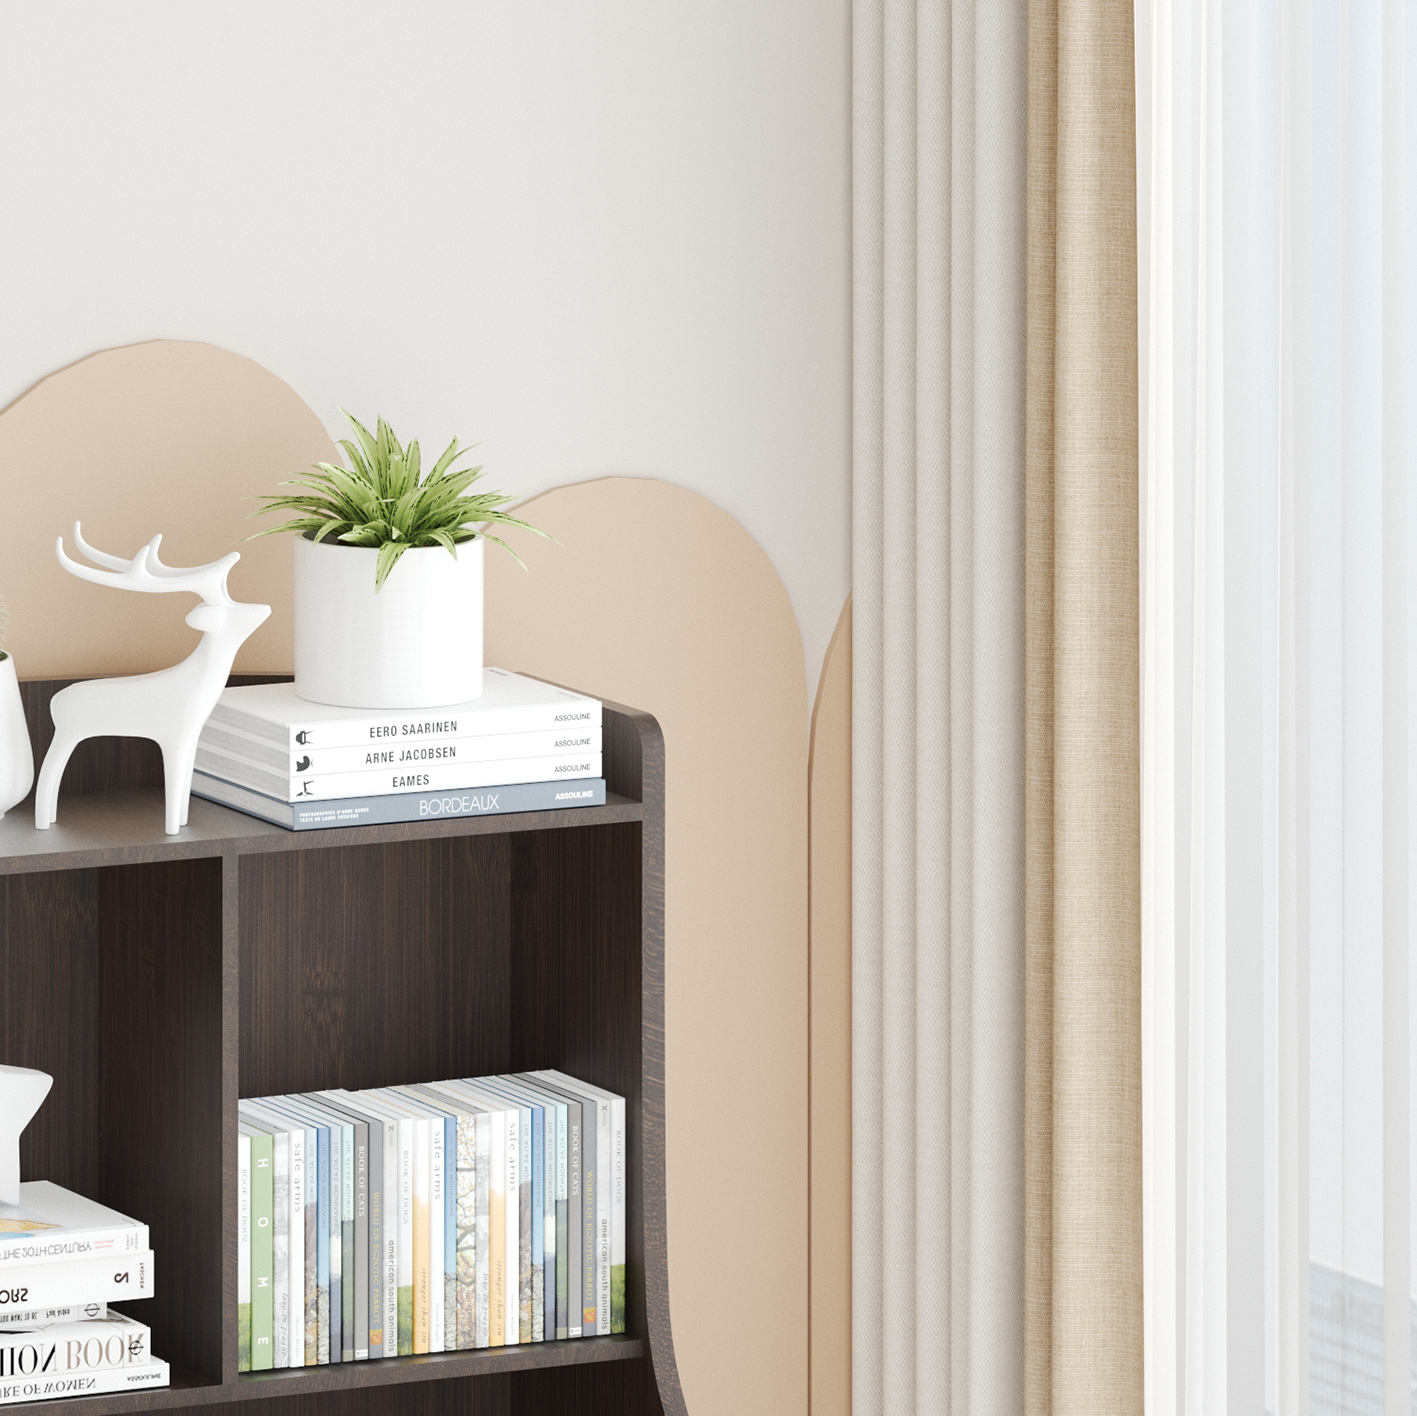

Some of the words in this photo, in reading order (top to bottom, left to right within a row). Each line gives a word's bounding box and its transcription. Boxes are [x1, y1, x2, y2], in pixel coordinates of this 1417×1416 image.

[370, 725, 397, 738] EERO
[402, 721, 457, 735] SAARINEN
[554, 713, 591, 722] ASSOULINE
[365, 751, 394, 764] ARNE
[399, 746, 456, 762] JACOBSEN
[554, 738, 591, 747] ASSOULINE
[392, 774, 429, 787] EAMES
[554, 764, 591, 773] ASSOULINE
[420, 794, 499, 815] BORDEAUX
[555, 790, 594, 800] ASSOULINE
[433, 1131, 444, 1159] safe
[509, 1123, 519, 1151] safe
[294, 1142, 304, 1172] safe
[572, 1156, 579, 1169] OF
[616, 1161, 622, 1174] OF
[358, 1177, 365, 1189] OF
[433, 1165, 441, 1199] arms
[509, 1157, 517, 1191] arms
[294, 1177, 302, 1213] arms
[402, 1181, 409, 1194] OF
[586, 1171, 594, 1204] WORLD
[586, 1208, 594, 1220] OF
[373, 1229, 380, 1241] OF
[586, 1223, 594, 1264] EGZOTIC
[601, 1219, 610, 1262] american
[388, 1240, 397, 1283] american
[586, 1267, 594, 1301] PARROT
[601, 1265, 610, 1291] south
[388, 1287, 397, 1313] south
[601, 1294, 610, 1330] animals
[388, 1315, 397, 1352] animals
